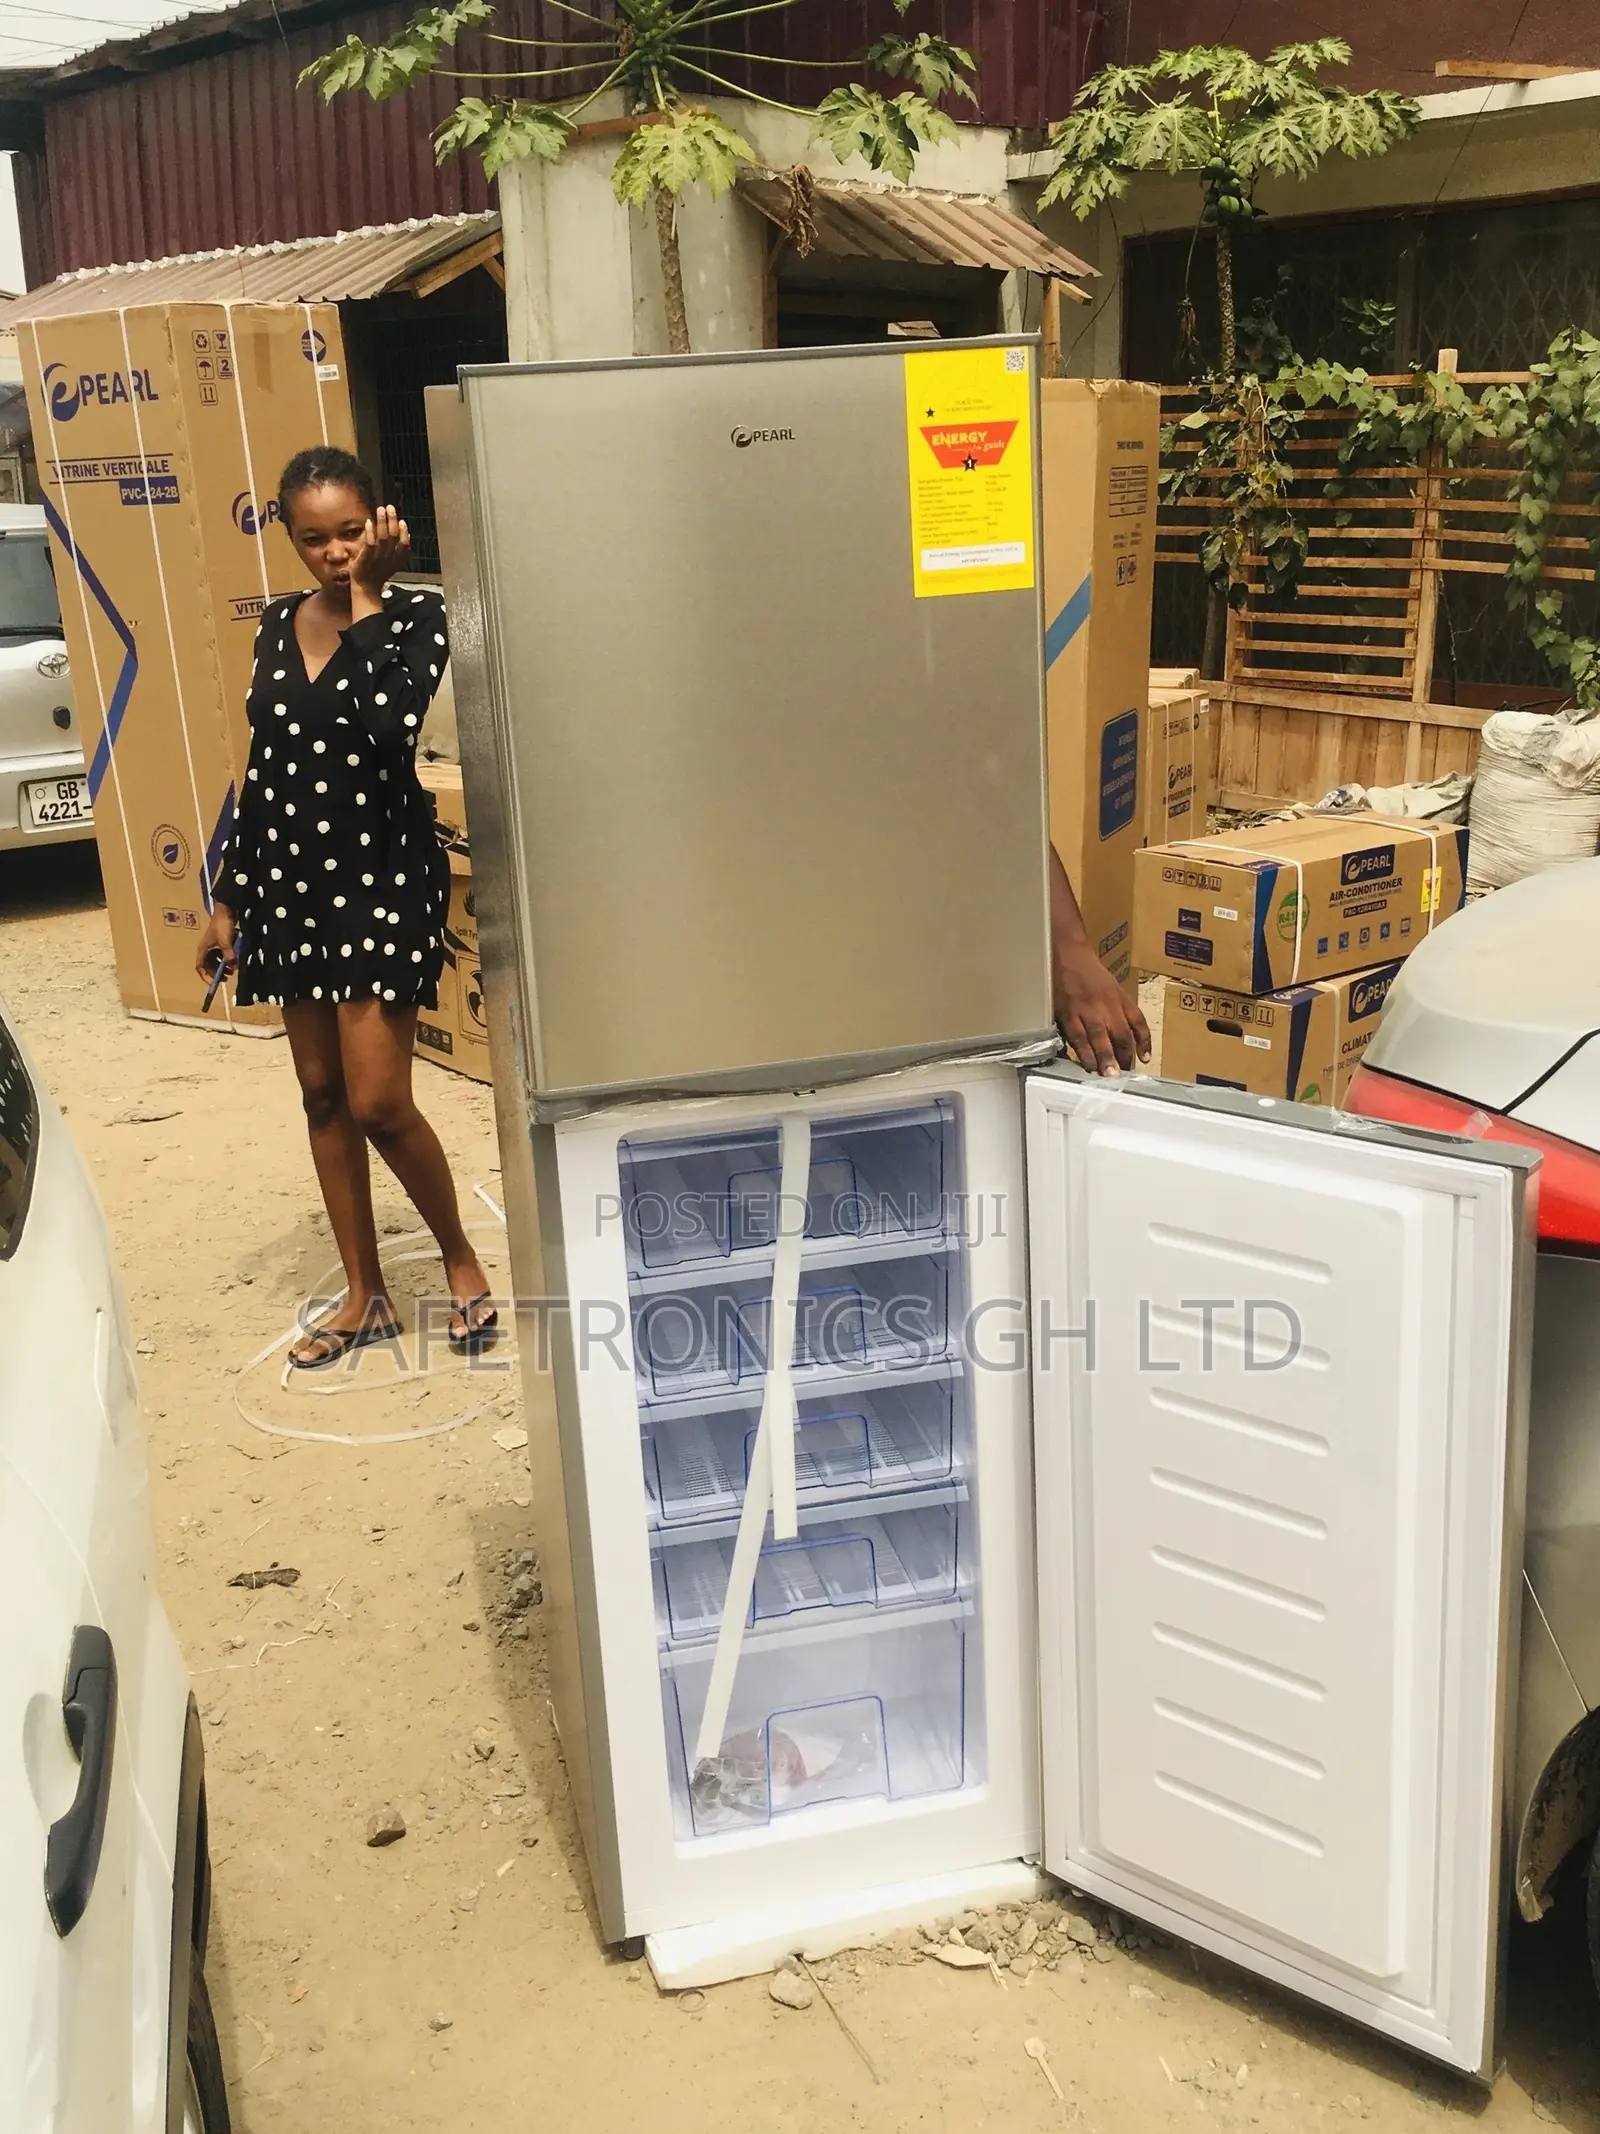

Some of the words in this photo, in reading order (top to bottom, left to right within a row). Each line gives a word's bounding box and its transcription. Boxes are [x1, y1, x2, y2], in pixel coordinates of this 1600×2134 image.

[221, 359, 230, 372] 2
[79, 368, 160, 407] PEARL
[752, 427, 796, 443] PEARL
[932, 430, 988, 450] ENERGY
[52, 463, 101, 479] VITRINE
[102, 459, 170, 476] VERTICALE
[967, 458, 973, 469] 1
[235, 601, 268, 616] VITR
[56, 781, 80, 801] GB
[1360, 854, 1392, 873] PEARL
[1328, 877, 1403, 903] AIR-CONDITIONER
[1367, 977, 1394, 1003] PEAR
[1241, 1004, 1250, 1016] 6
[1341, 1031, 1373, 1055] CLIMAT
